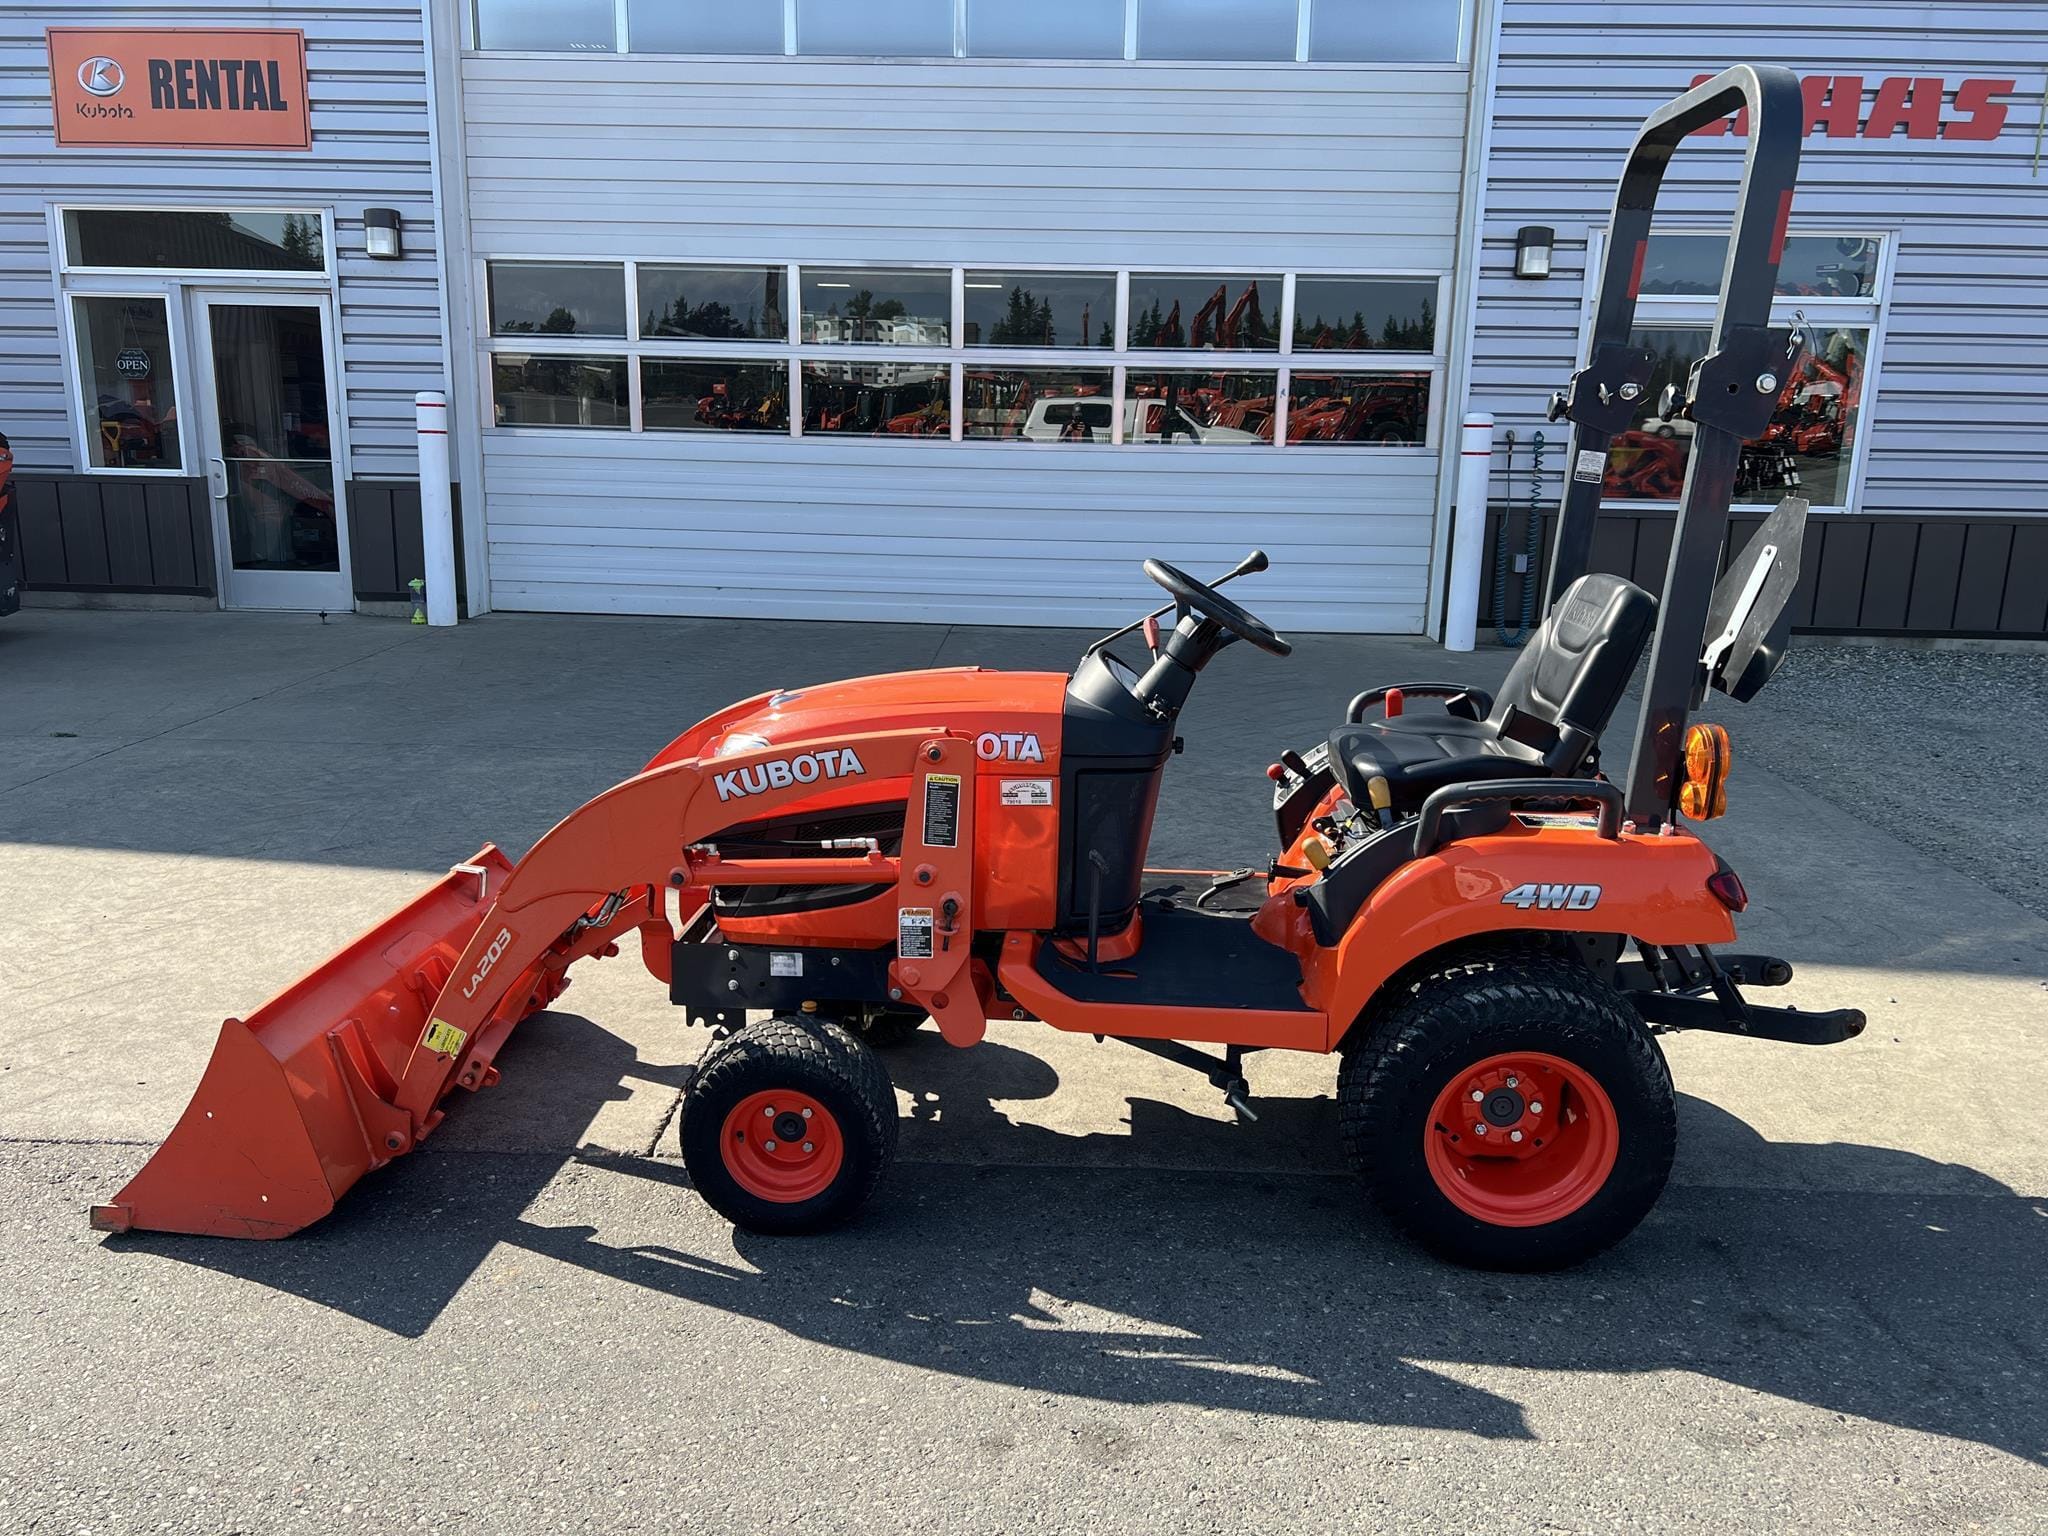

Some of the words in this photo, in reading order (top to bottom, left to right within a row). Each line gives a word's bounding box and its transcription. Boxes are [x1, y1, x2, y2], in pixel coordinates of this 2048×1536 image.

[148, 59, 288, 111] RENTAL
[76, 103, 133, 118] Kubota
[1688, 74, 2016, 141] AAS
[117, 359, 148, 370] OPEN
[976, 731, 1044, 763] OTA
[713, 746, 867, 802] KUBOTA
[1501, 883, 1602, 911] 4WD
[462, 927, 512, 998] LA203
